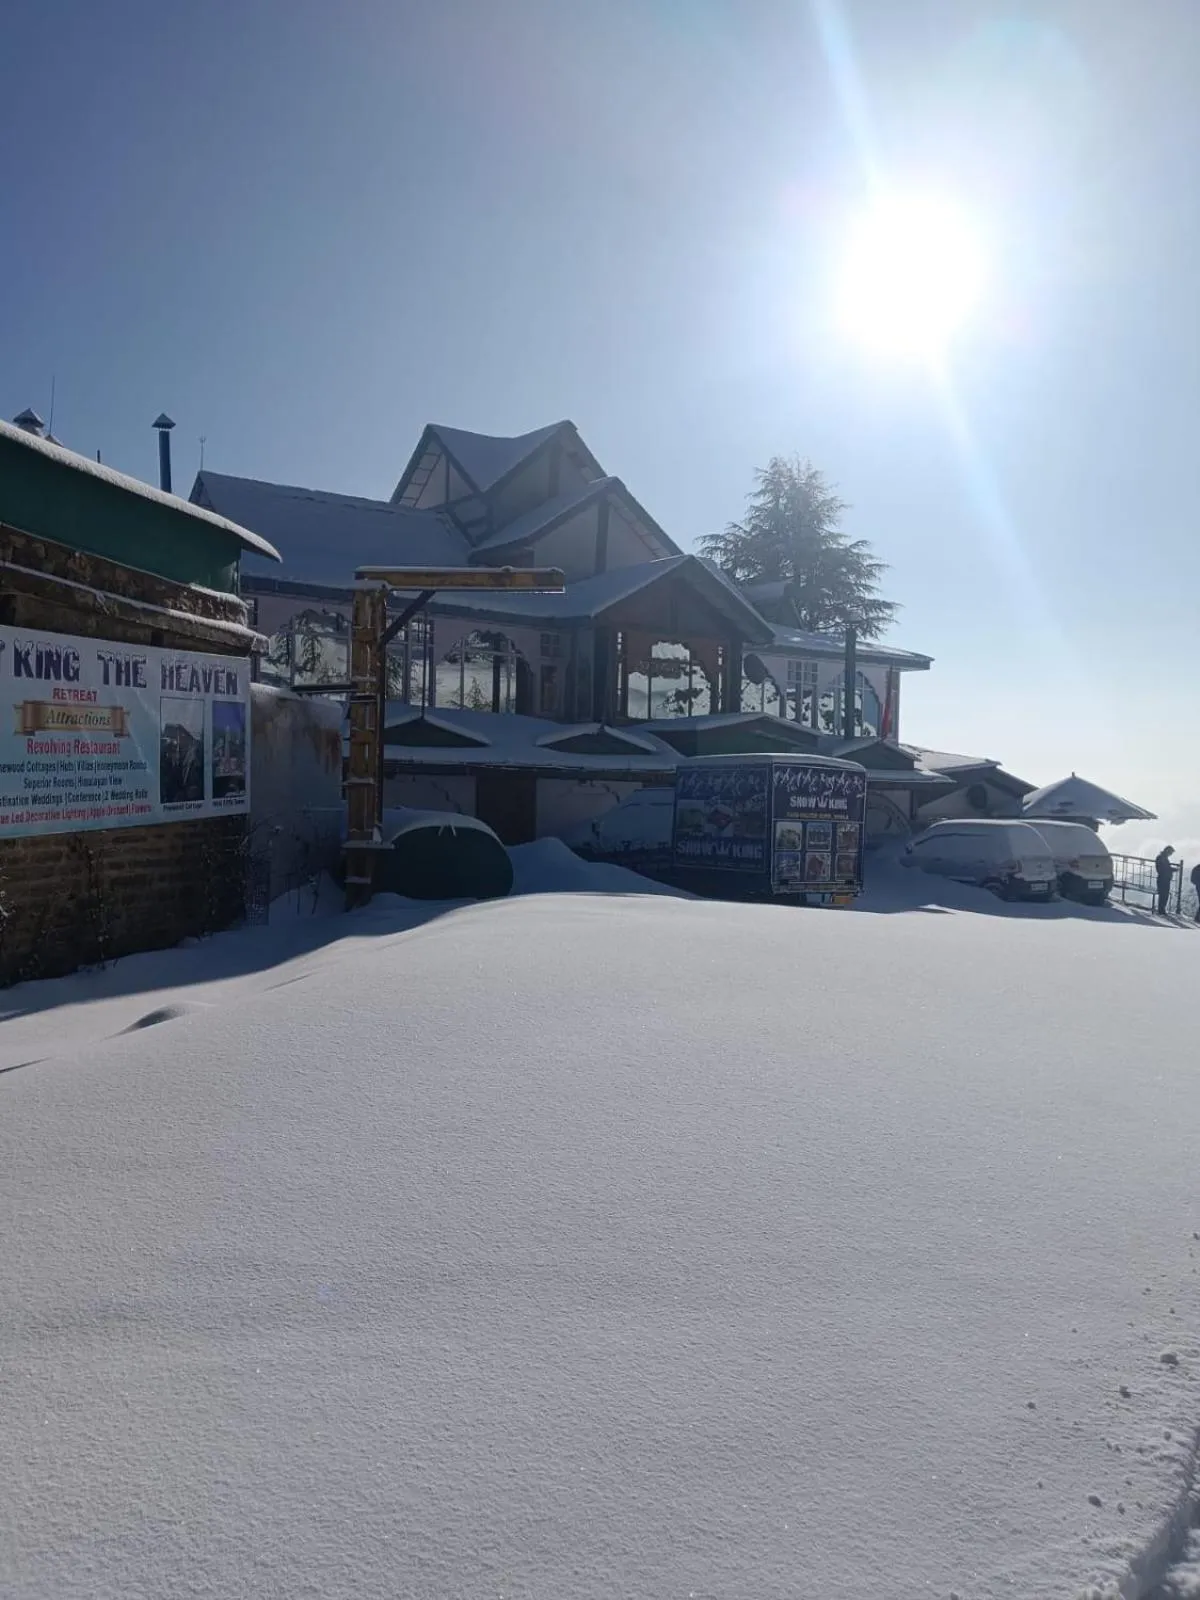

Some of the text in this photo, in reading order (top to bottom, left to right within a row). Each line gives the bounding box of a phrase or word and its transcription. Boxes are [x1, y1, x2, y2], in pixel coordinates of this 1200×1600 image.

[13, 639, 80, 682] KING
[97, 649, 147, 688] THE
[160, 657, 238, 695] HEAVEN
[52, 688, 98, 702] RETREAT
[44, 709, 112, 727] Attractions
[26, 739, 121, 757] Revolving Restaurant
[26, 761, 56, 774] Cottages
[23, 777, 52, 791] Superior
[53, 776, 75, 788] Rooms
[31, 793, 63, 807] Weddings
[110, 789, 134, 801] Wedding
[828, 798, 848, 810] KING
